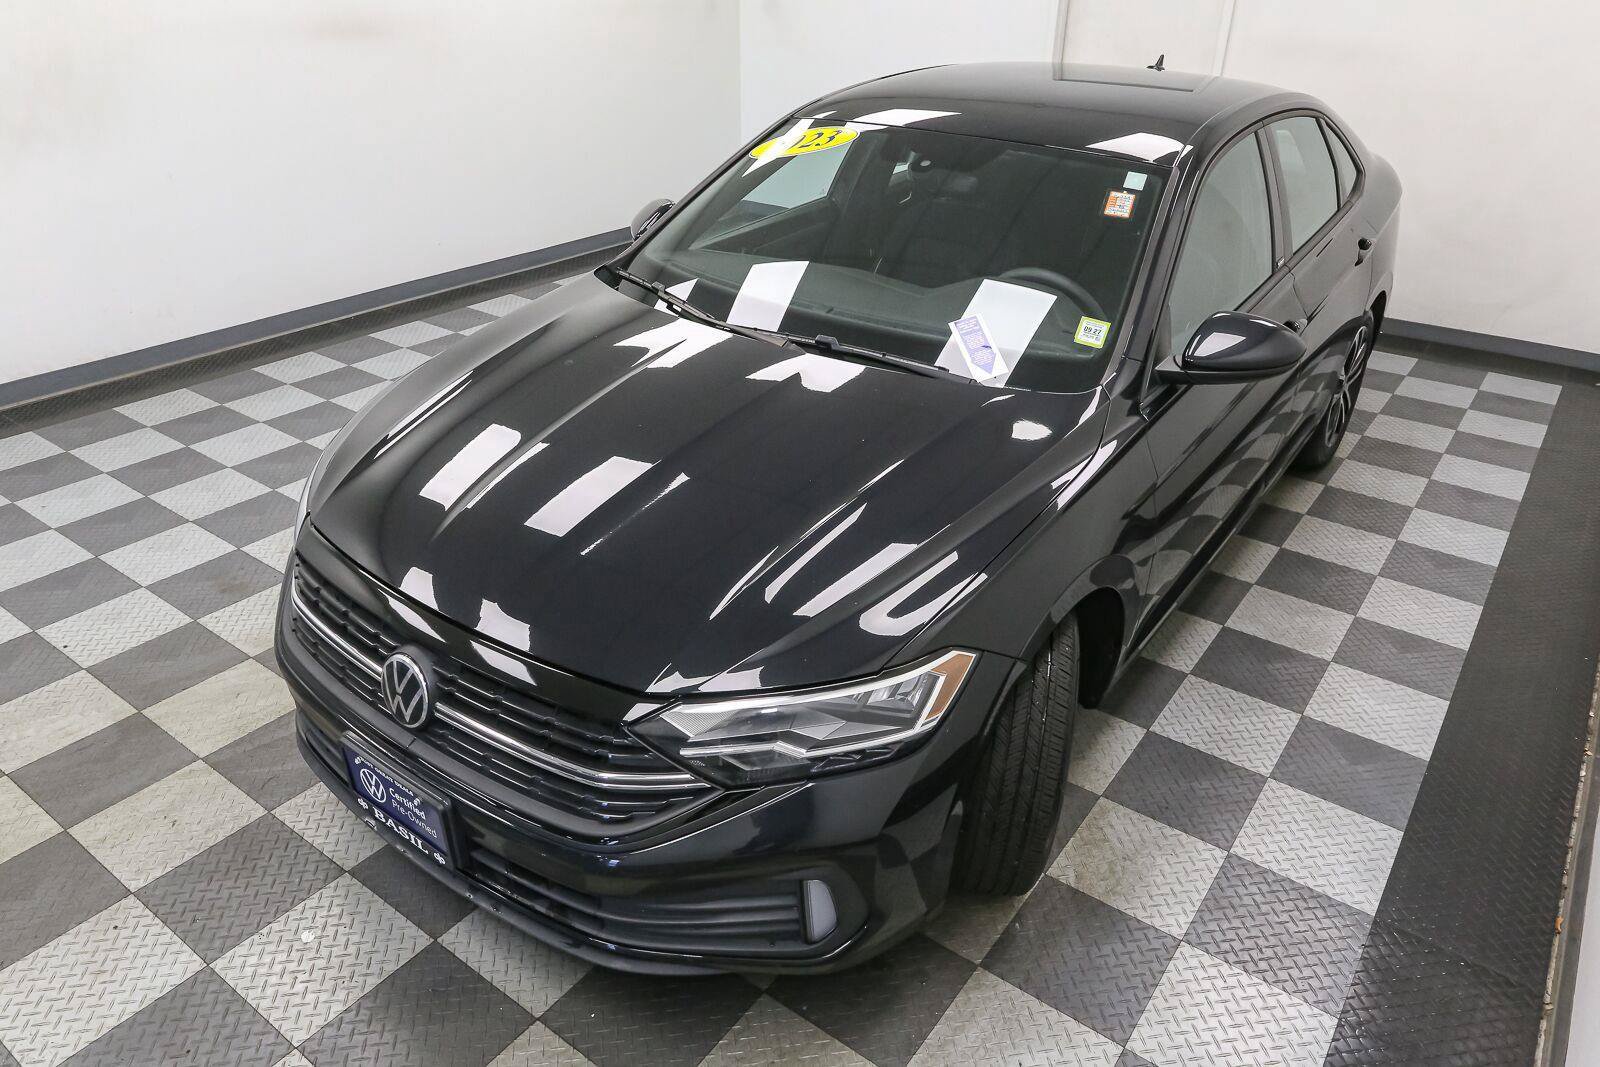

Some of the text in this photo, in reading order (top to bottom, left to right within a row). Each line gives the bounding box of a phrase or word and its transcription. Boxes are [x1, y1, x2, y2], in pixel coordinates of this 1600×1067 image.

[389, 788, 426, 820] Certified
[391, 799, 438, 839] Pre-Owned
[372, 806, 429, 855] BASIL
